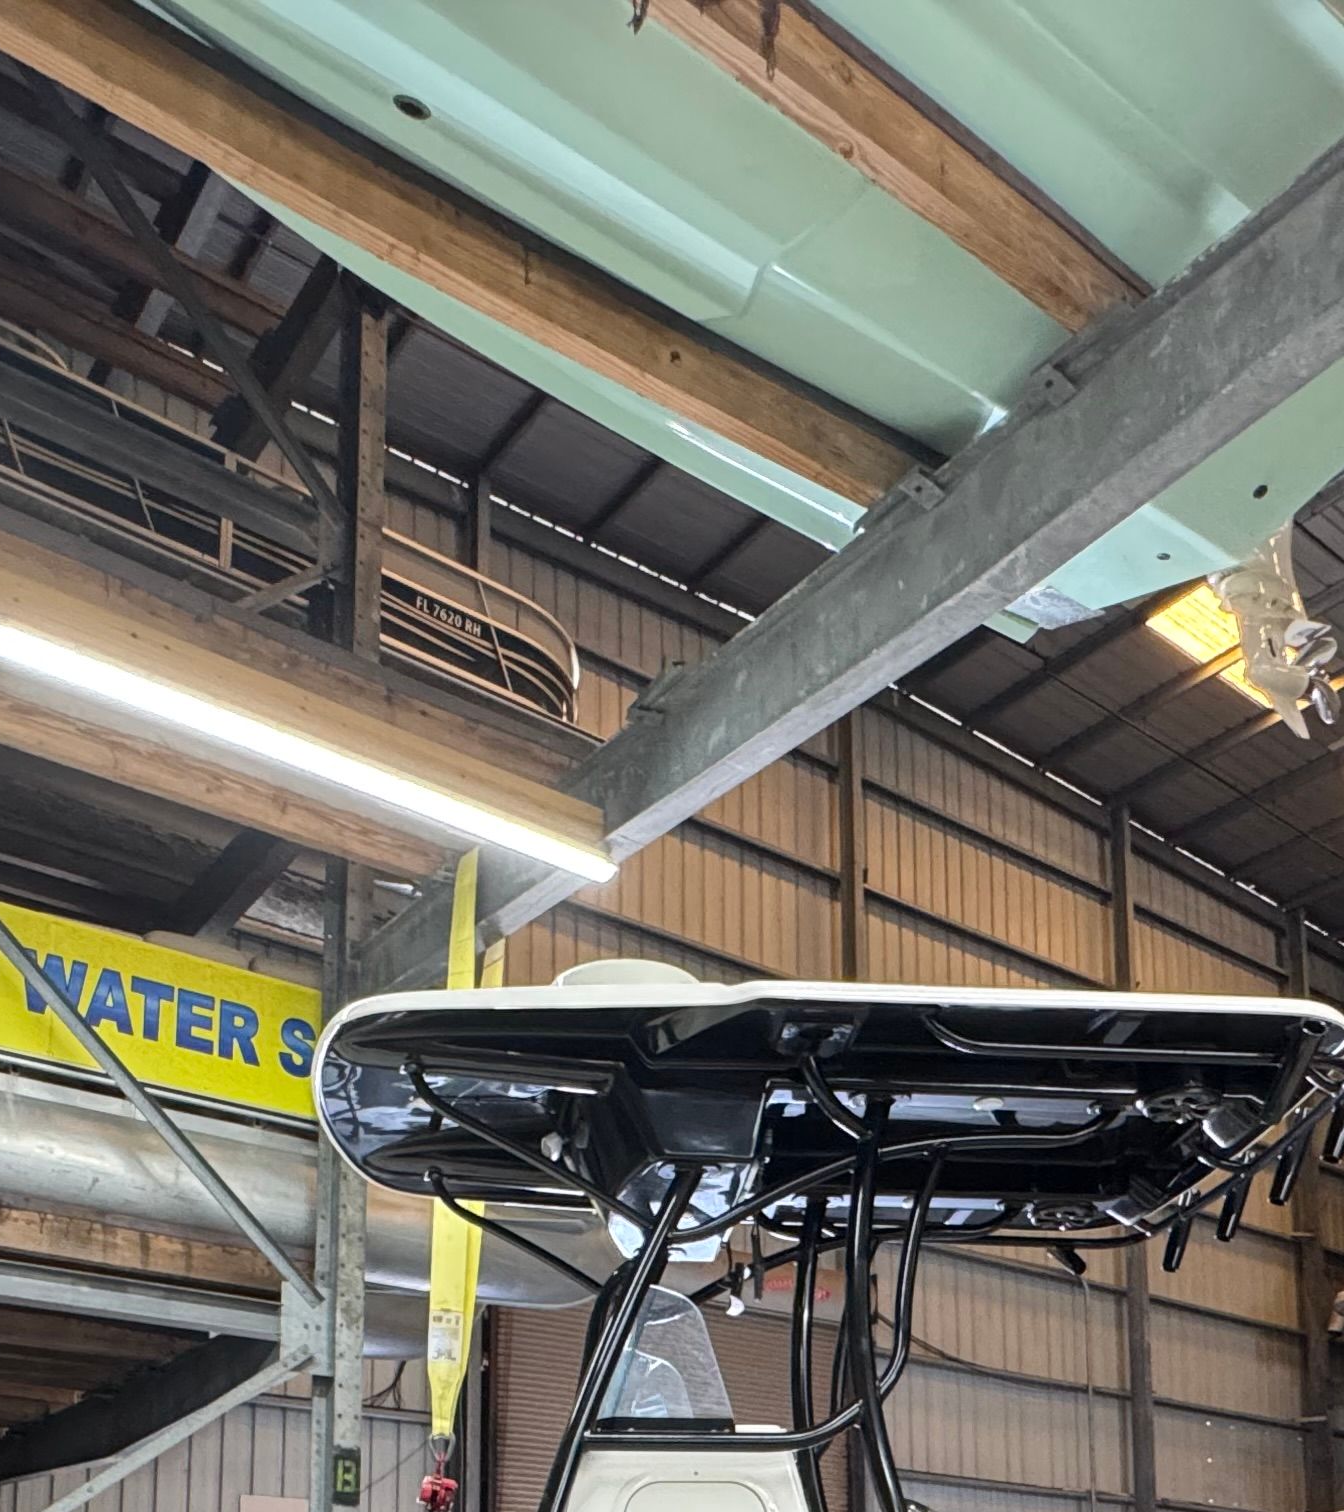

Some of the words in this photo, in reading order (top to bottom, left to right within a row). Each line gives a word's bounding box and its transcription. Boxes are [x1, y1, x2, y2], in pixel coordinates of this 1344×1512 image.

[416, 595, 430, 613] FL
[433, 603, 463, 628] 7620
[464, 617, 482, 638] RH
[22, 946, 261, 1067] WATER
[335, 1458, 357, 1493] B
